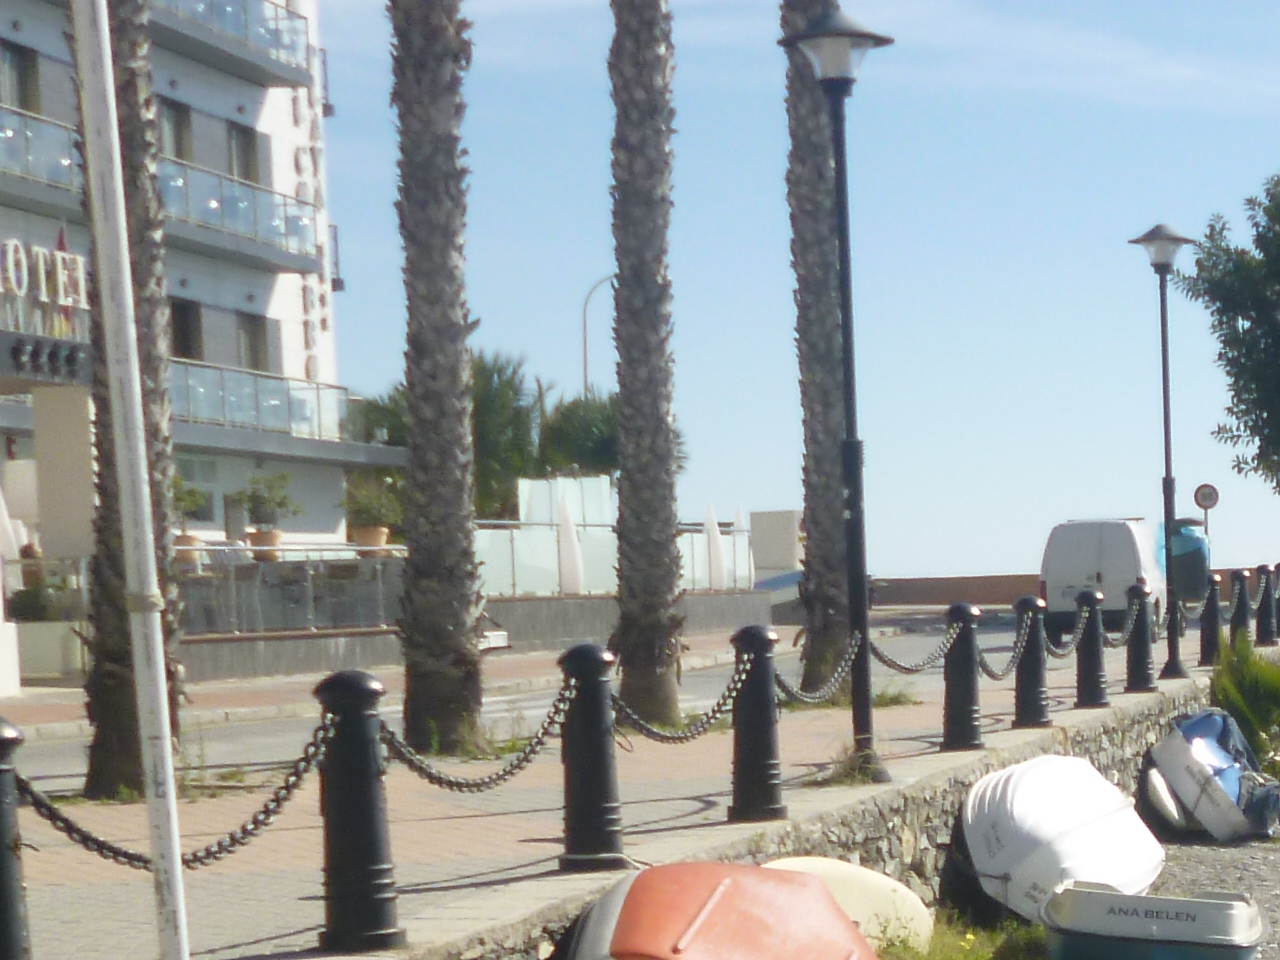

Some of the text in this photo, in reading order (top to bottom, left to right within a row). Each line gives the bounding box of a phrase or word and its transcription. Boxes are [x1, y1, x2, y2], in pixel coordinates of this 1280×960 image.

[0, 238, 91, 310] OTEL
[1106, 906, 1197, 923] ANA BELEN
